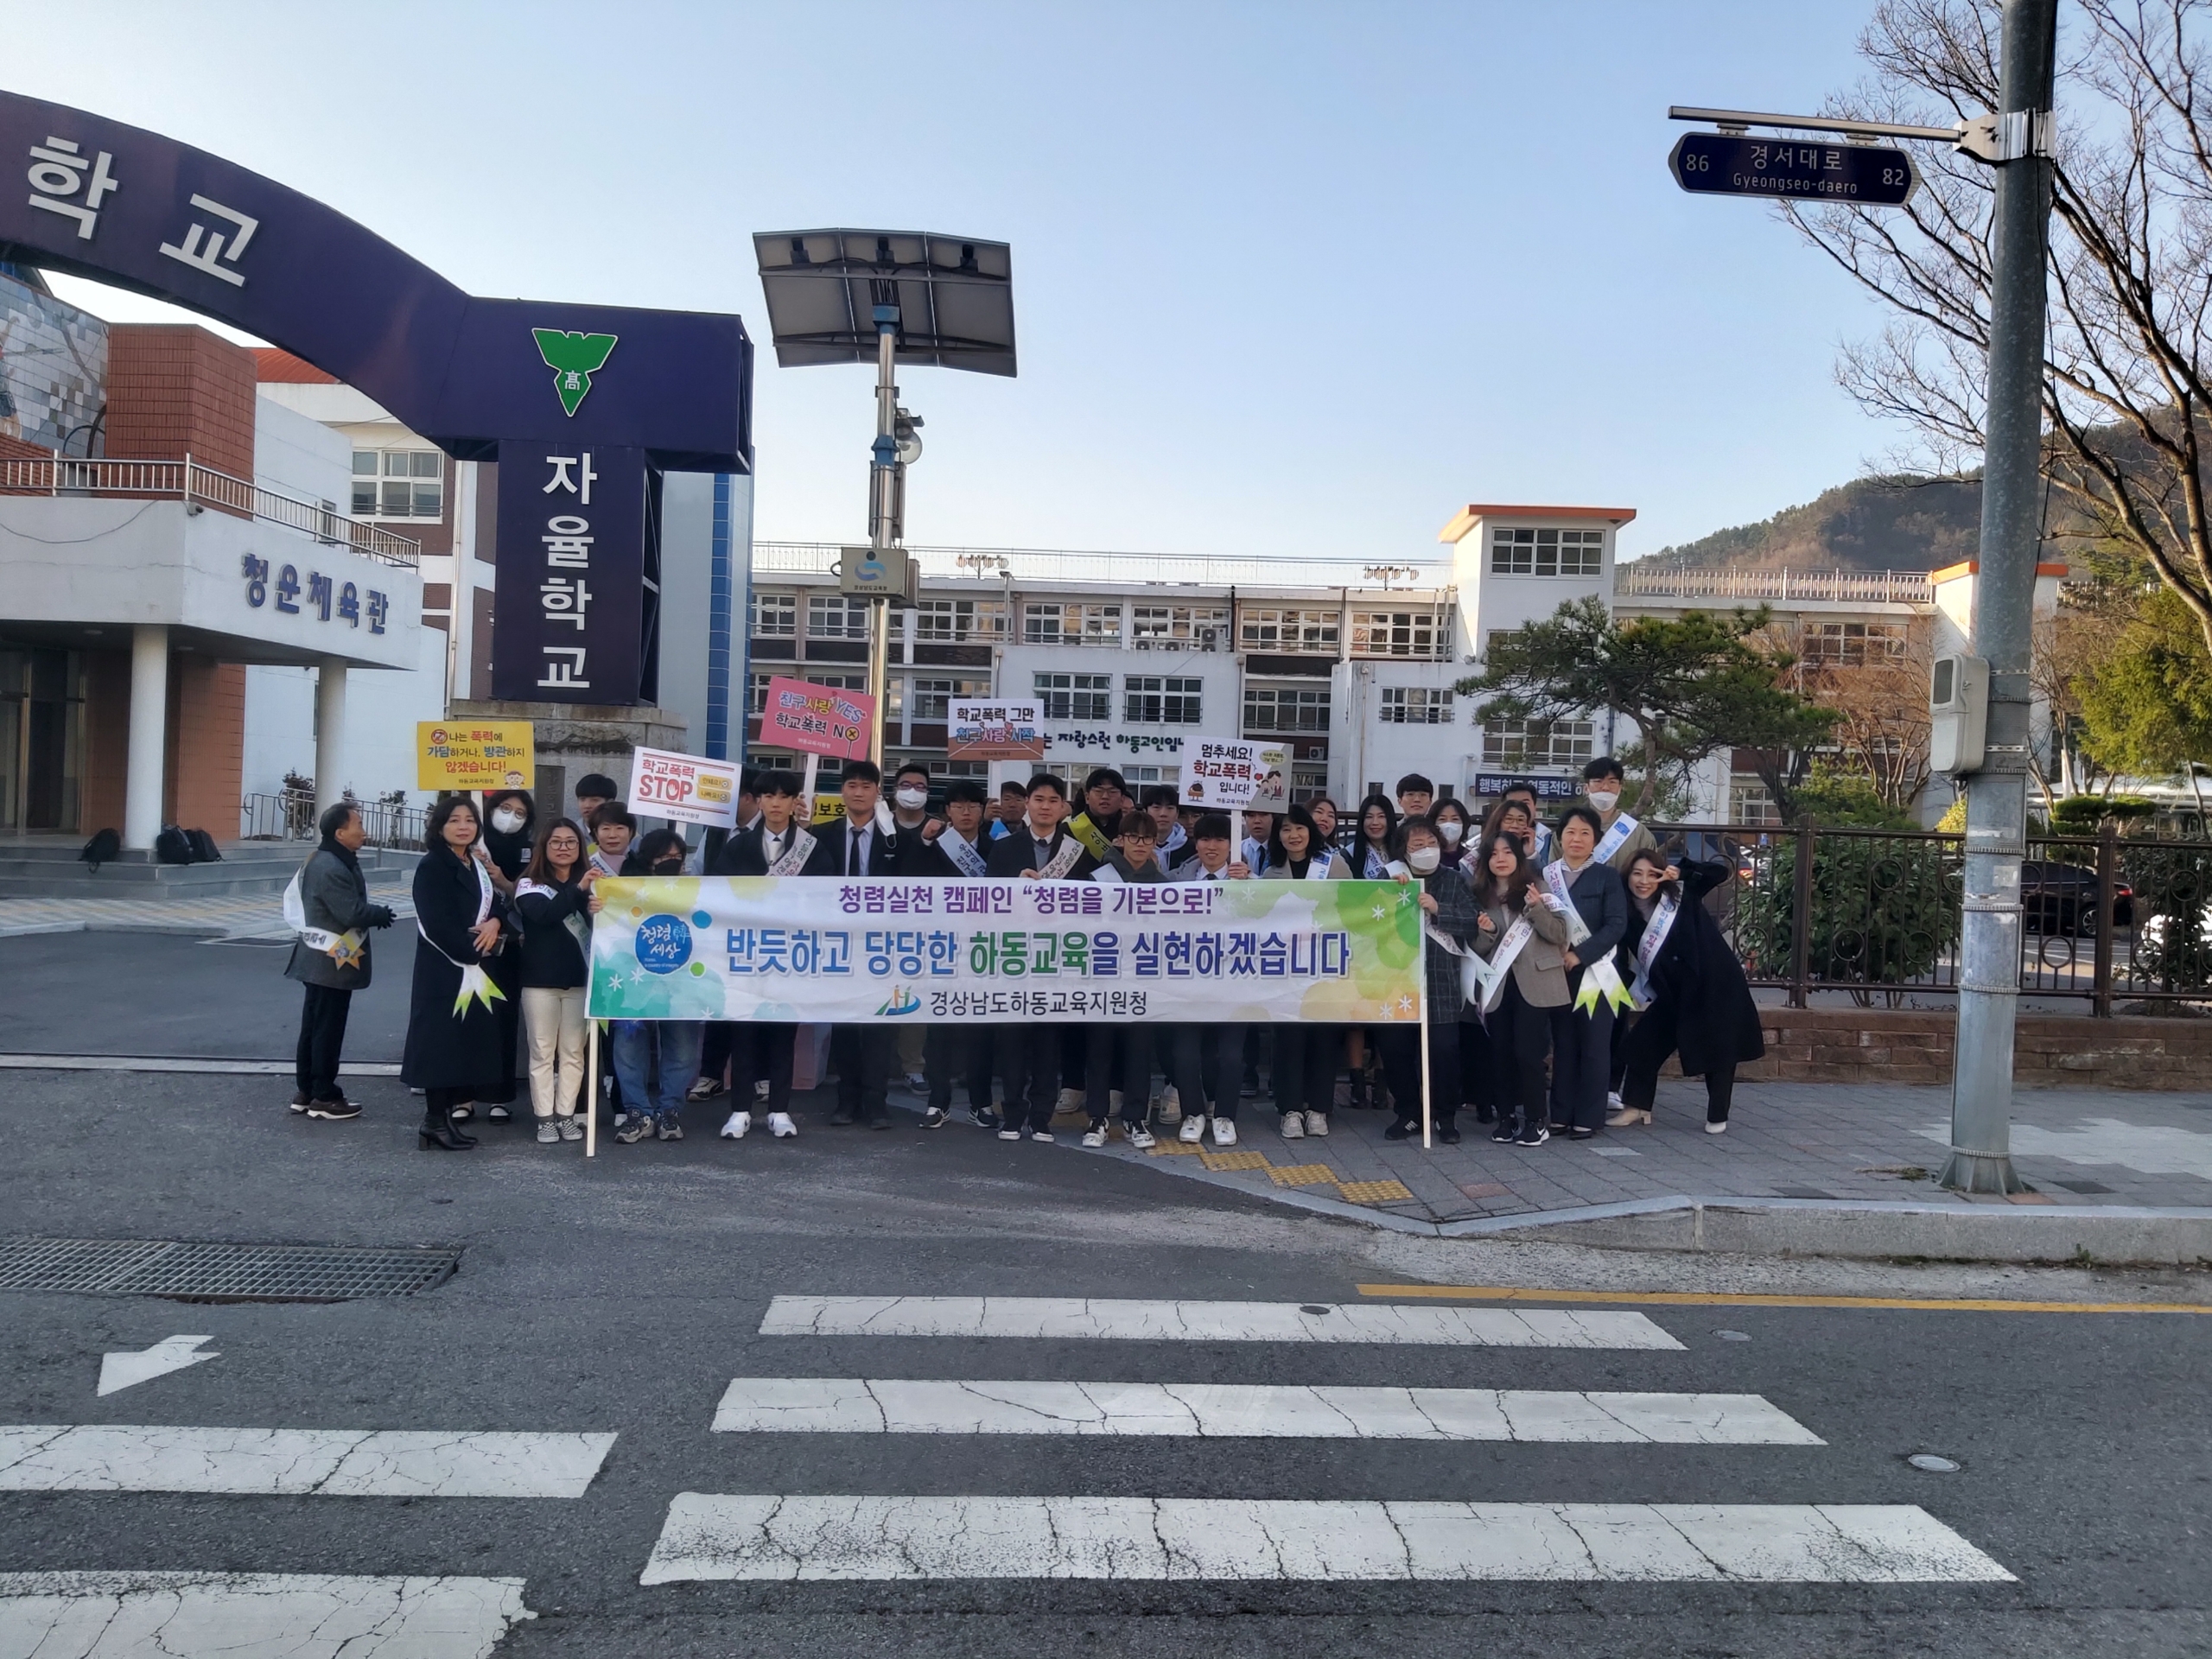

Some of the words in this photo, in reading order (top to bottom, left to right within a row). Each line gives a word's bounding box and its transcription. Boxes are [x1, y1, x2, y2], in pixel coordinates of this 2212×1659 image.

[1686, 154, 1709, 172] 86
[1750, 145, 1843, 170] 경서대로
[1732, 172, 1858, 194] Gyeongseo-daero
[1882, 168, 1904, 186] 82
[537, 452, 598, 689] 자율학교
[241, 553, 389, 634] 청운체육관
[779, 690, 832, 715] 친구사랑
[835, 697, 863, 723] YES
[957, 708, 1006, 722] 학교폭력
[1010, 708, 1035, 722] 그만
[776, 713, 827, 735] 학교폭력
[448, 732, 467, 742] 나는
[471, 730, 503, 742] 폭력에
[957, 727, 1006, 742] 친구사랑
[1010, 728, 1035, 742] 시작
[1058, 730, 1110, 749] 자랑스런
[484, 746, 524, 758] 방관하지
[1201, 744, 1253, 762] 멈추세요!
[445, 760, 506, 773] 않겠습니다!
[642, 759, 695, 779] 학교폭력
[1193, 760, 1251, 781] 학교폭력
[639, 774, 693, 802] STOP
[1219, 781, 1250, 795] 입니다!
[1479, 778, 1523, 793] 행복하
[838, 886, 933, 914] 청렴실천
[943, 886, 1013, 914] 캠페인
[650, 942, 681, 959] 세상
[726, 928, 850, 976] 반듯하고
[866, 931, 957, 976] 당당한
[969, 931, 1119, 976] 하동교육을
[1131, 931, 1351, 976] 실현하겠습니다
[930, 990, 1147, 1016] 경상남도하동교육지원청
